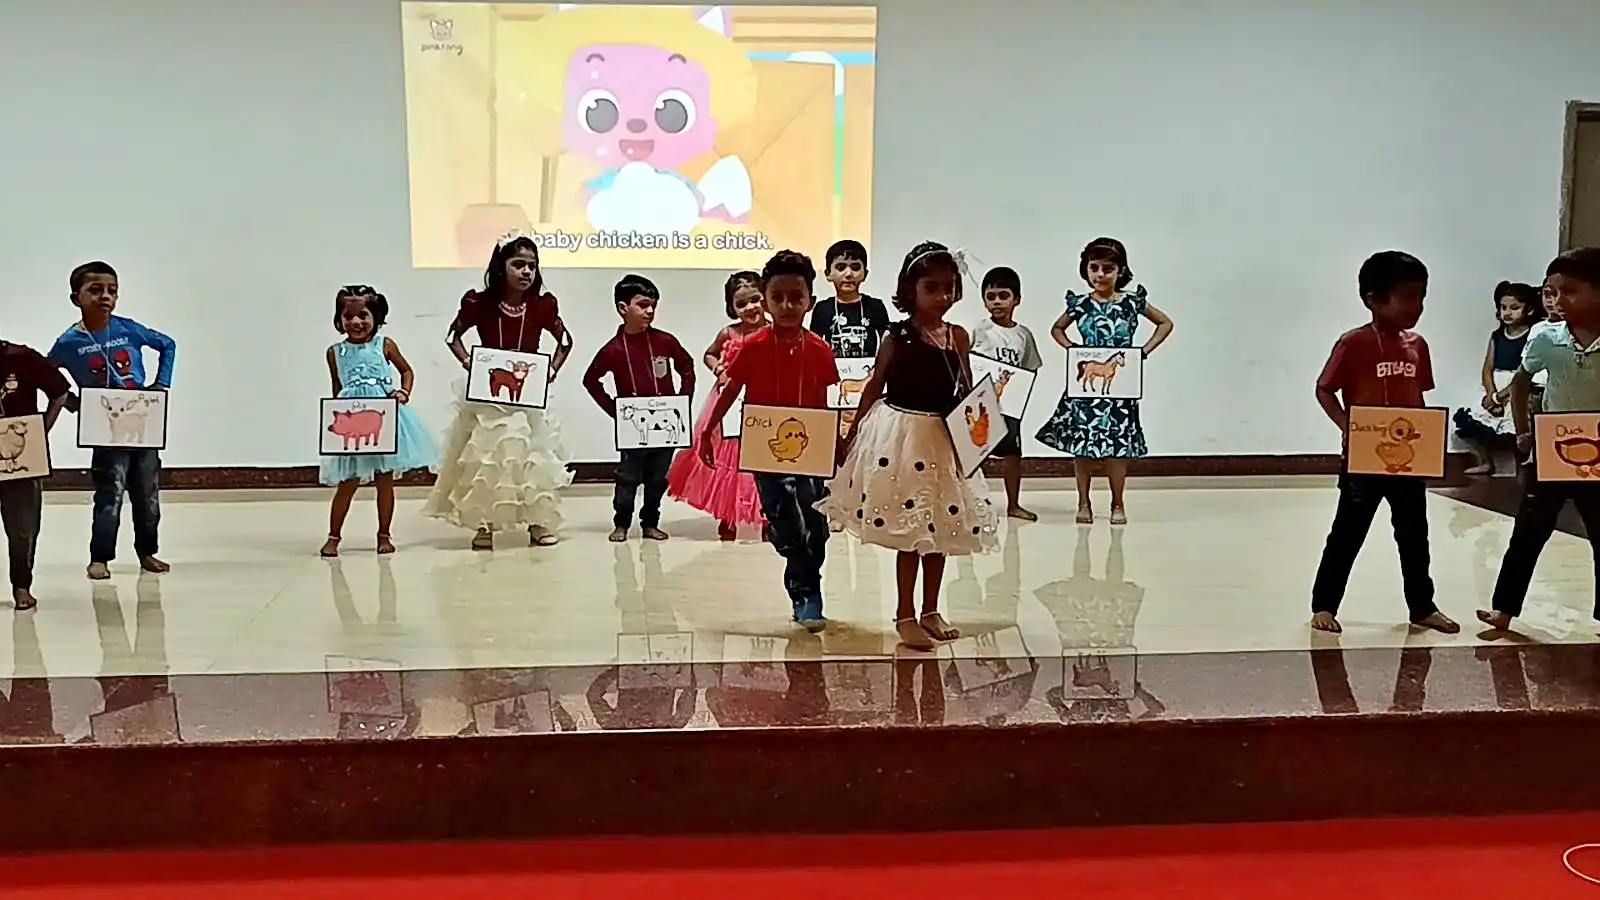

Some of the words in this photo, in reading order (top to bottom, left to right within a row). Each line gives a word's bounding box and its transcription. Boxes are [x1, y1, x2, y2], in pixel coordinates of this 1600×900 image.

[531, 229, 582, 252] baby
[587, 229, 668, 248] chicken
[672, 231, 690, 249] is
[694, 234, 708, 249] a
[712, 231, 775, 250] chick.
[1555, 424, 1584, 438] Duck
